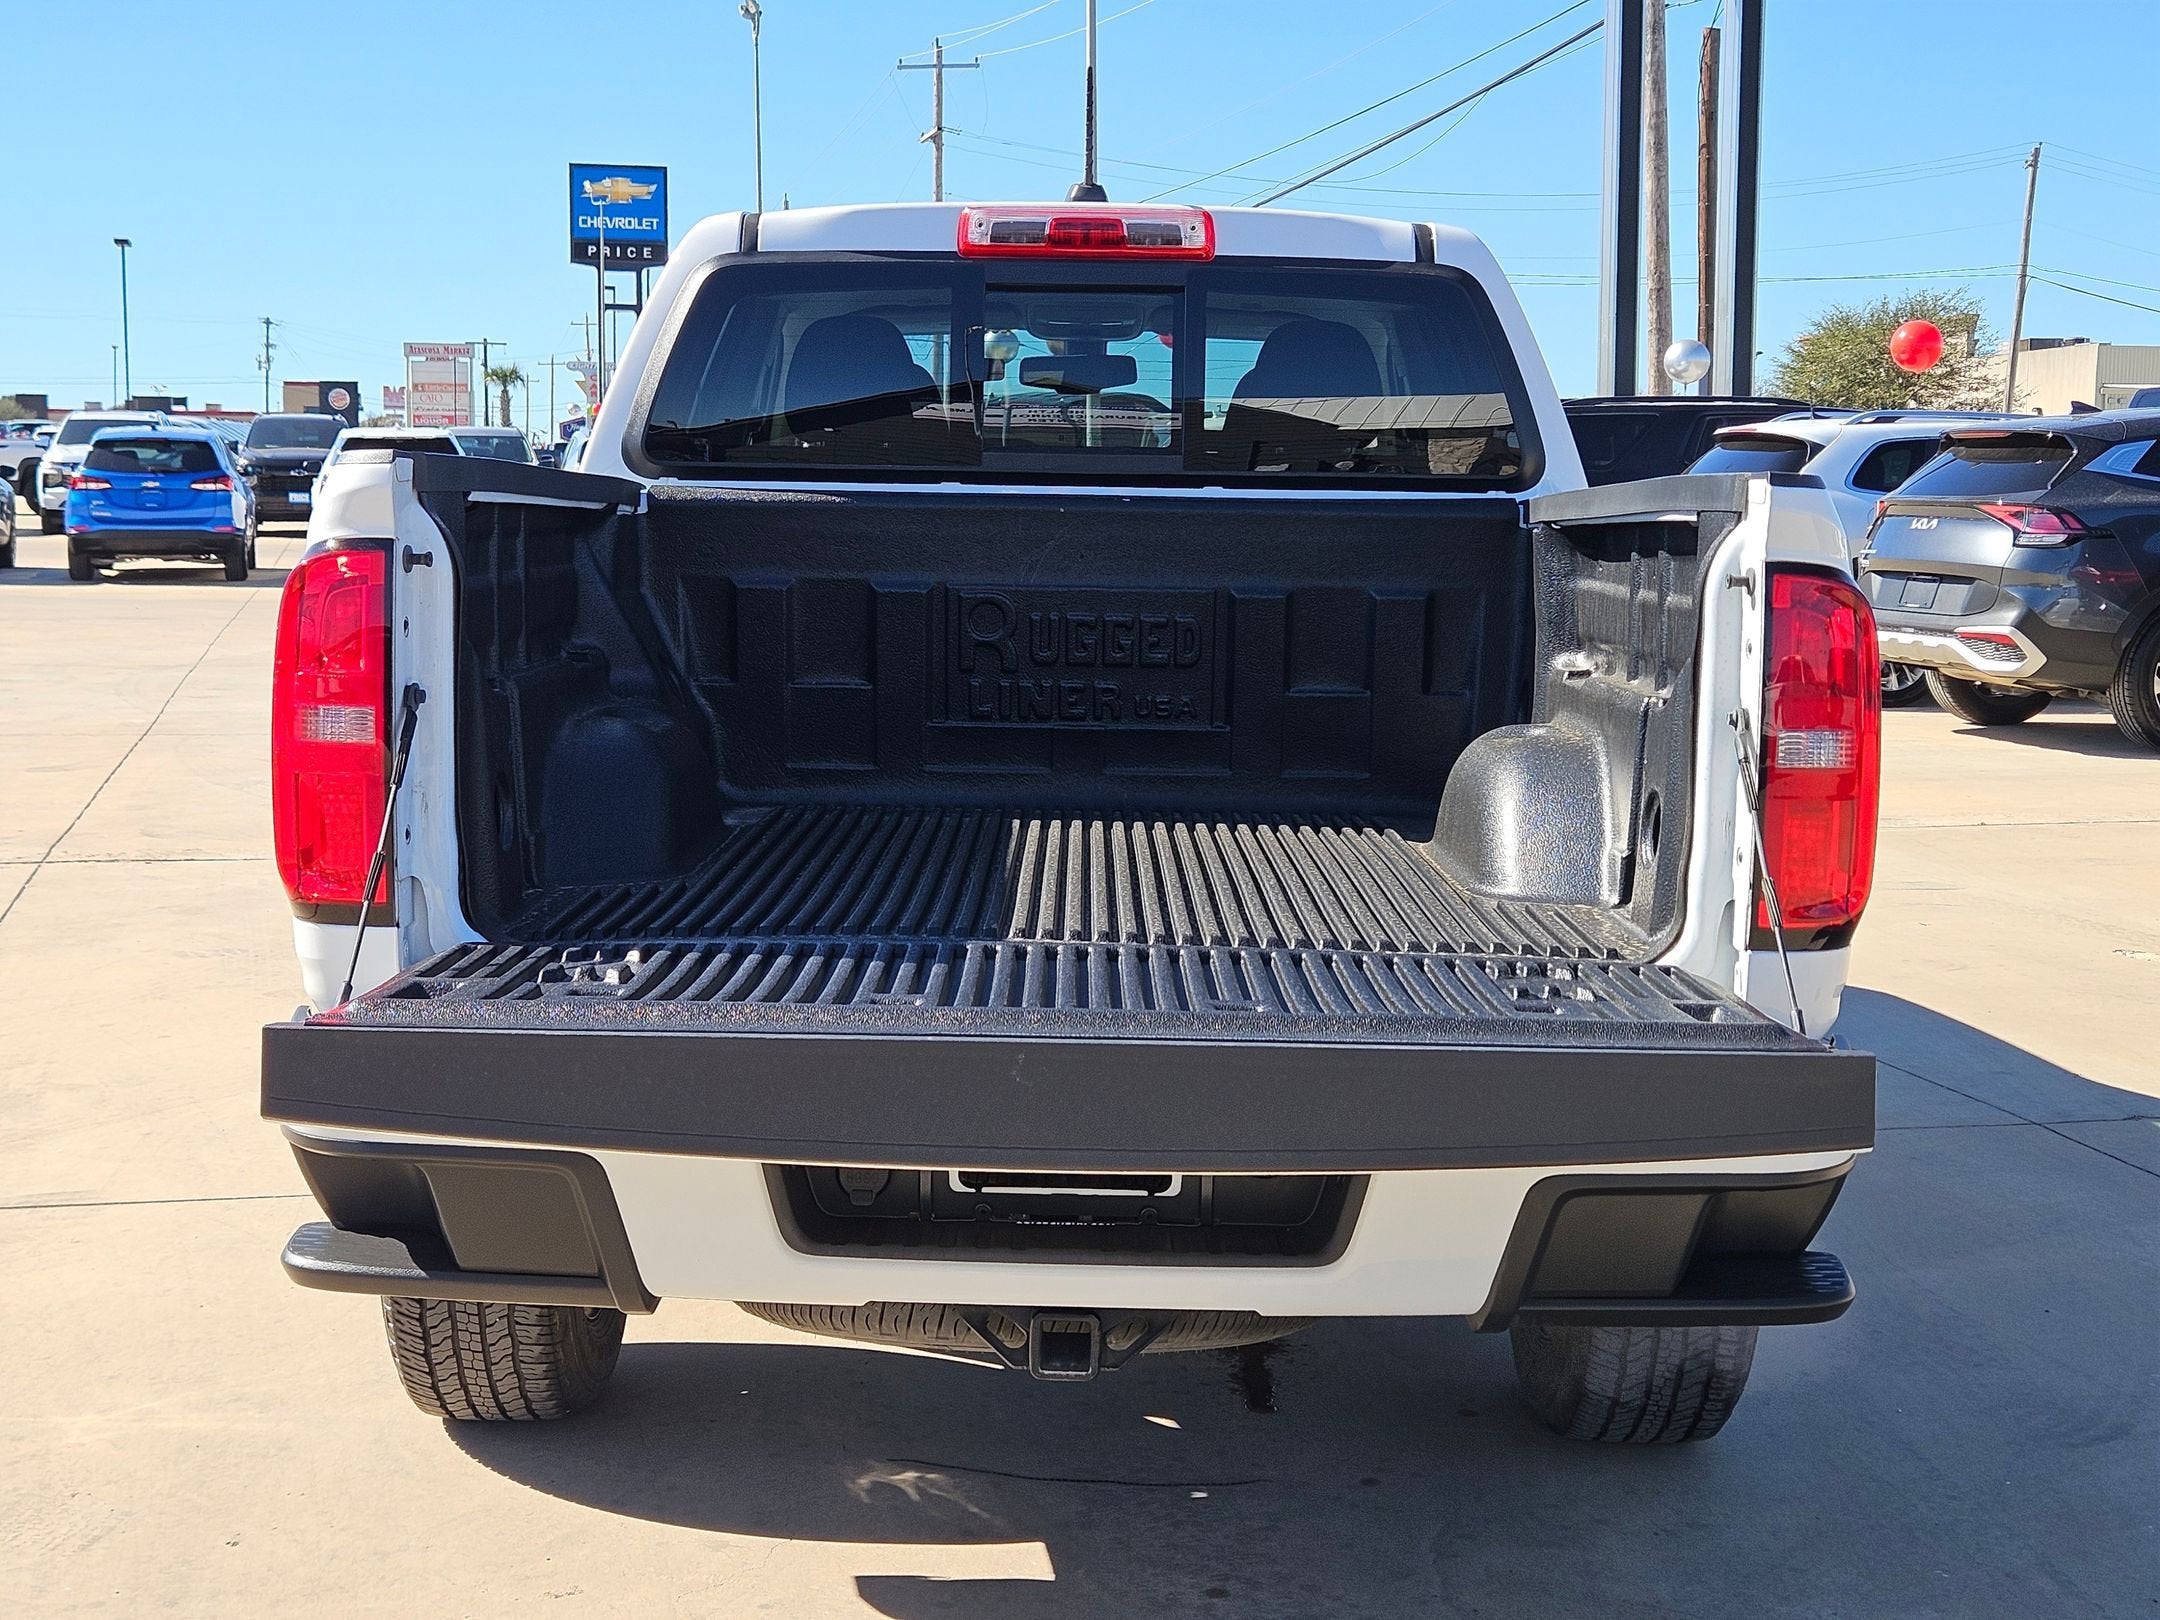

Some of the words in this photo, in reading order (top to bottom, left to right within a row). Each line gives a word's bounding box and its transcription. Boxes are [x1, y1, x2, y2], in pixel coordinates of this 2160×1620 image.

[578, 215, 660, 230] CHEVROLET
[587, 245, 652, 259] PRICE
[958, 589, 1200, 673] RUGGED
[968, 678, 1122, 721] LINER
[1134, 694, 1198, 719] USA
